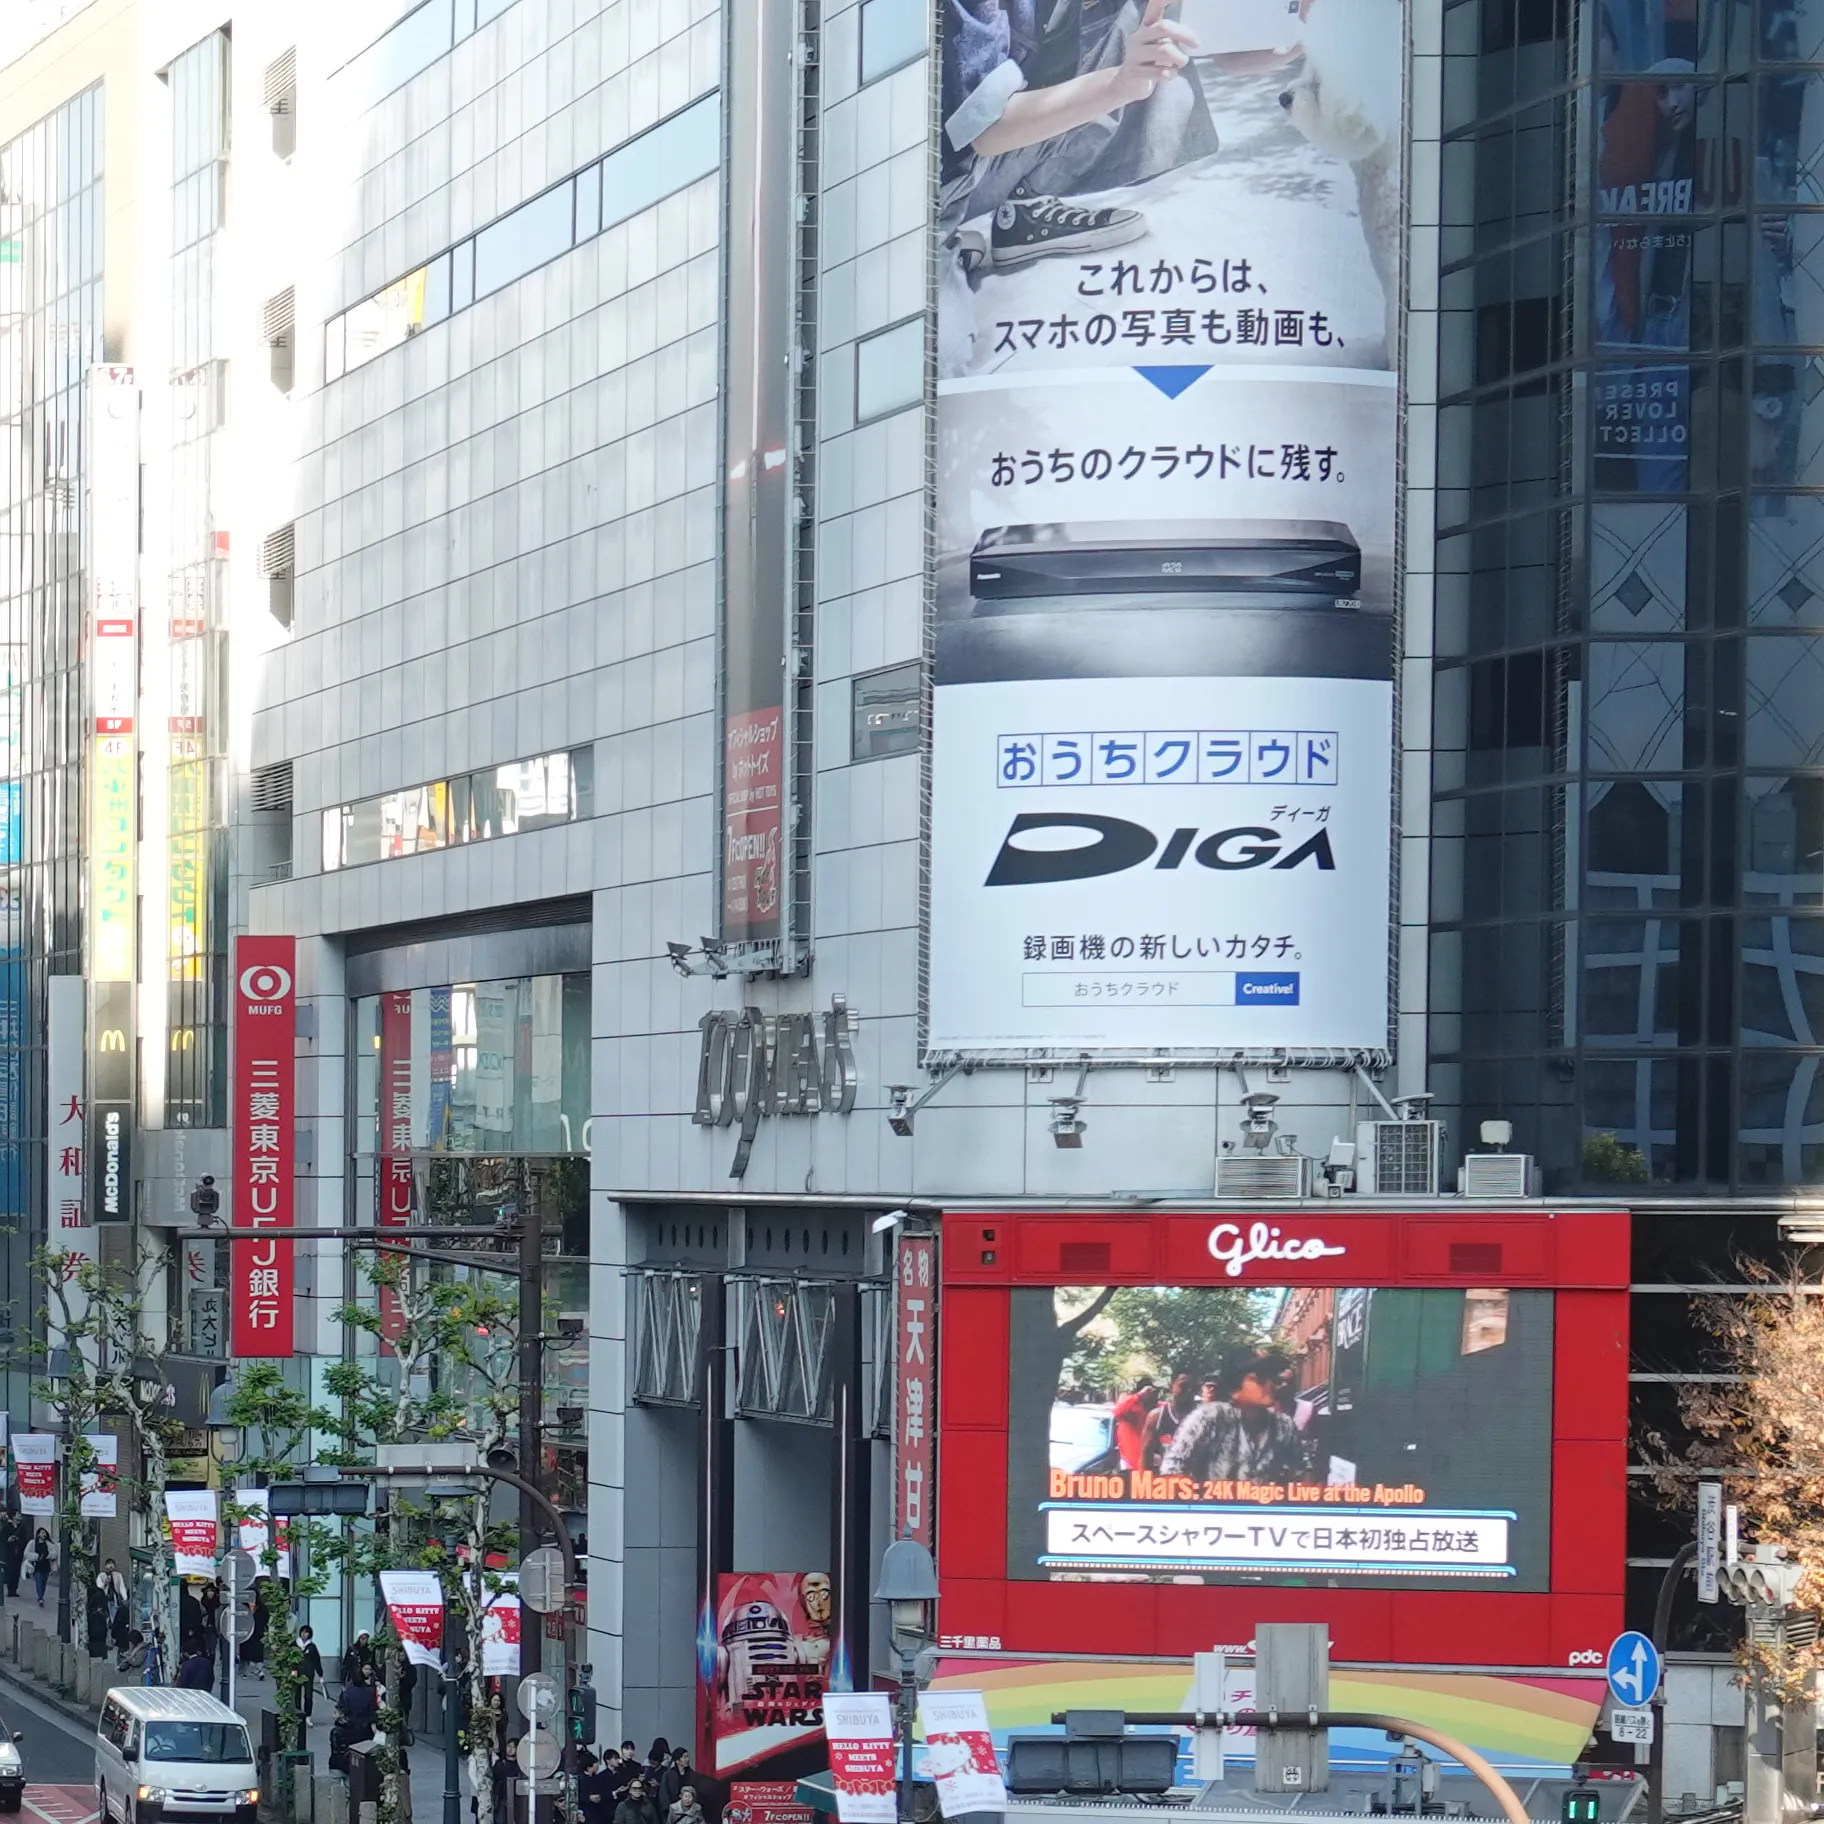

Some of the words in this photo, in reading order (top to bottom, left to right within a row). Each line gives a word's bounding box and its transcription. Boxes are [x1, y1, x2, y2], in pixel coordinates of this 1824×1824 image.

[1075, 258, 1270, 297] これからは、
[992, 308, 1347, 354] スマホの写真も動画も、
[990, 442, 1347, 487] おうちのクラウドに残す。
[1002, 738, 1332, 782] おうちクラウド
[1270, 805, 1331, 823] ディーガ
[983, 812, 1337, 887] DIGA
[1022, 933, 1303, 962] 録画機の新しいカタチ。
[1073, 981, 1180, 998] おうちクラウド
[248, 1005, 283, 1016] MUFG
[103, 1110, 120, 1214] McDonald's
[59, 1093, 90, 1283] 大和証券
[248, 1059, 280, 1330] 三菱東京UFJ銀行
[1207, 1222, 1346, 1277] Glico
[903, 1248, 933, 1287] 名物
[1049, 1469, 1124, 1502] Bruno
[1131, 1471, 1199, 1502] Mars:
[1203, 1481, 1234, 1502] 24K
[1236, 1482, 1284, 1506] Magic
[1288, 1482, 1320, 1504] Live
[1322, 1484, 1340, 1504] at
[1341, 1483, 1370, 1504] the
[1373, 1483, 1425, 1507] Apollo
[1071, 1520, 1480, 1554] スペースシャワーTVで日本初独占放送
[391, 1584, 432, 1597] SHIBUYA
[415, 1606, 440, 1615] KITTY
[939, 1634, 1002, 1651] 三千里薬品
[1568, 1648, 1602, 1668] pdc
[742, 1681, 823, 1700] STAR
[744, 1708, 824, 1727] WARS
[836, 1714, 880, 1726] SHIBUYA
[932, 1708, 978, 1720] SHIBUYA
[1618, 1727, 1648, 1740] 8-22
[832, 1742, 860, 1751] HELLO
[862, 1741, 890, 1750] KITTY
[848, 1753, 877, 1761] MEETS
[845, 1763, 885, 1773] SHIBUYA
